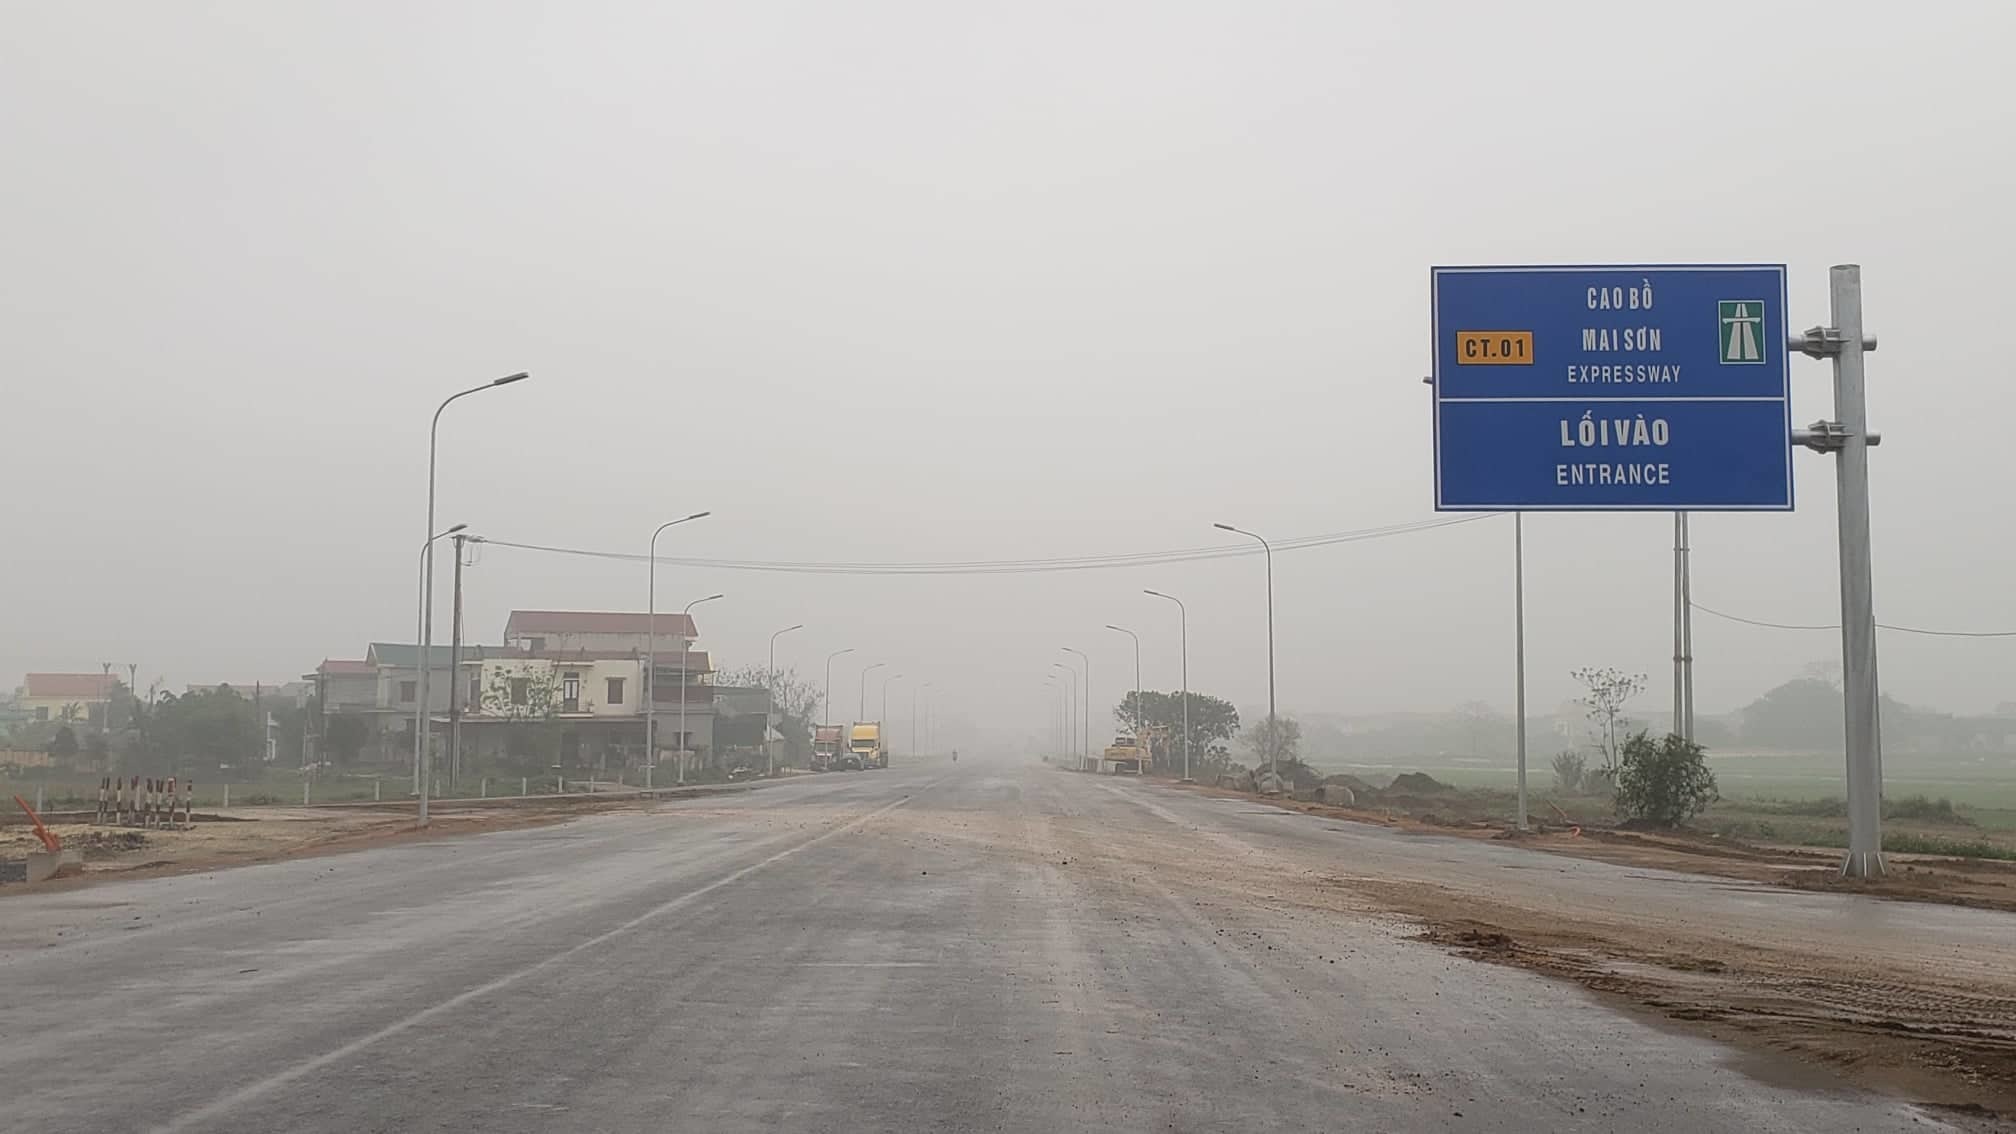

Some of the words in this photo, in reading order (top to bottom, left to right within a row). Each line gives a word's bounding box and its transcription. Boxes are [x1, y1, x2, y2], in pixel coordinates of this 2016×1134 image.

[1587, 287, 1622, 310] CAO
[1630, 279, 1652, 310] BỒ
[1465, 339, 1525, 358] CT.01
[1582, 329, 1618, 351] MAI
[1624, 326, 1661, 351] SƠN
[1568, 366, 1681, 384] EXPRESSWAY
[1561, 410, 1608, 446] LỐI
[1616, 414, 1669, 446] VÀO
[1557, 464, 1669, 485] ENTRANCE
